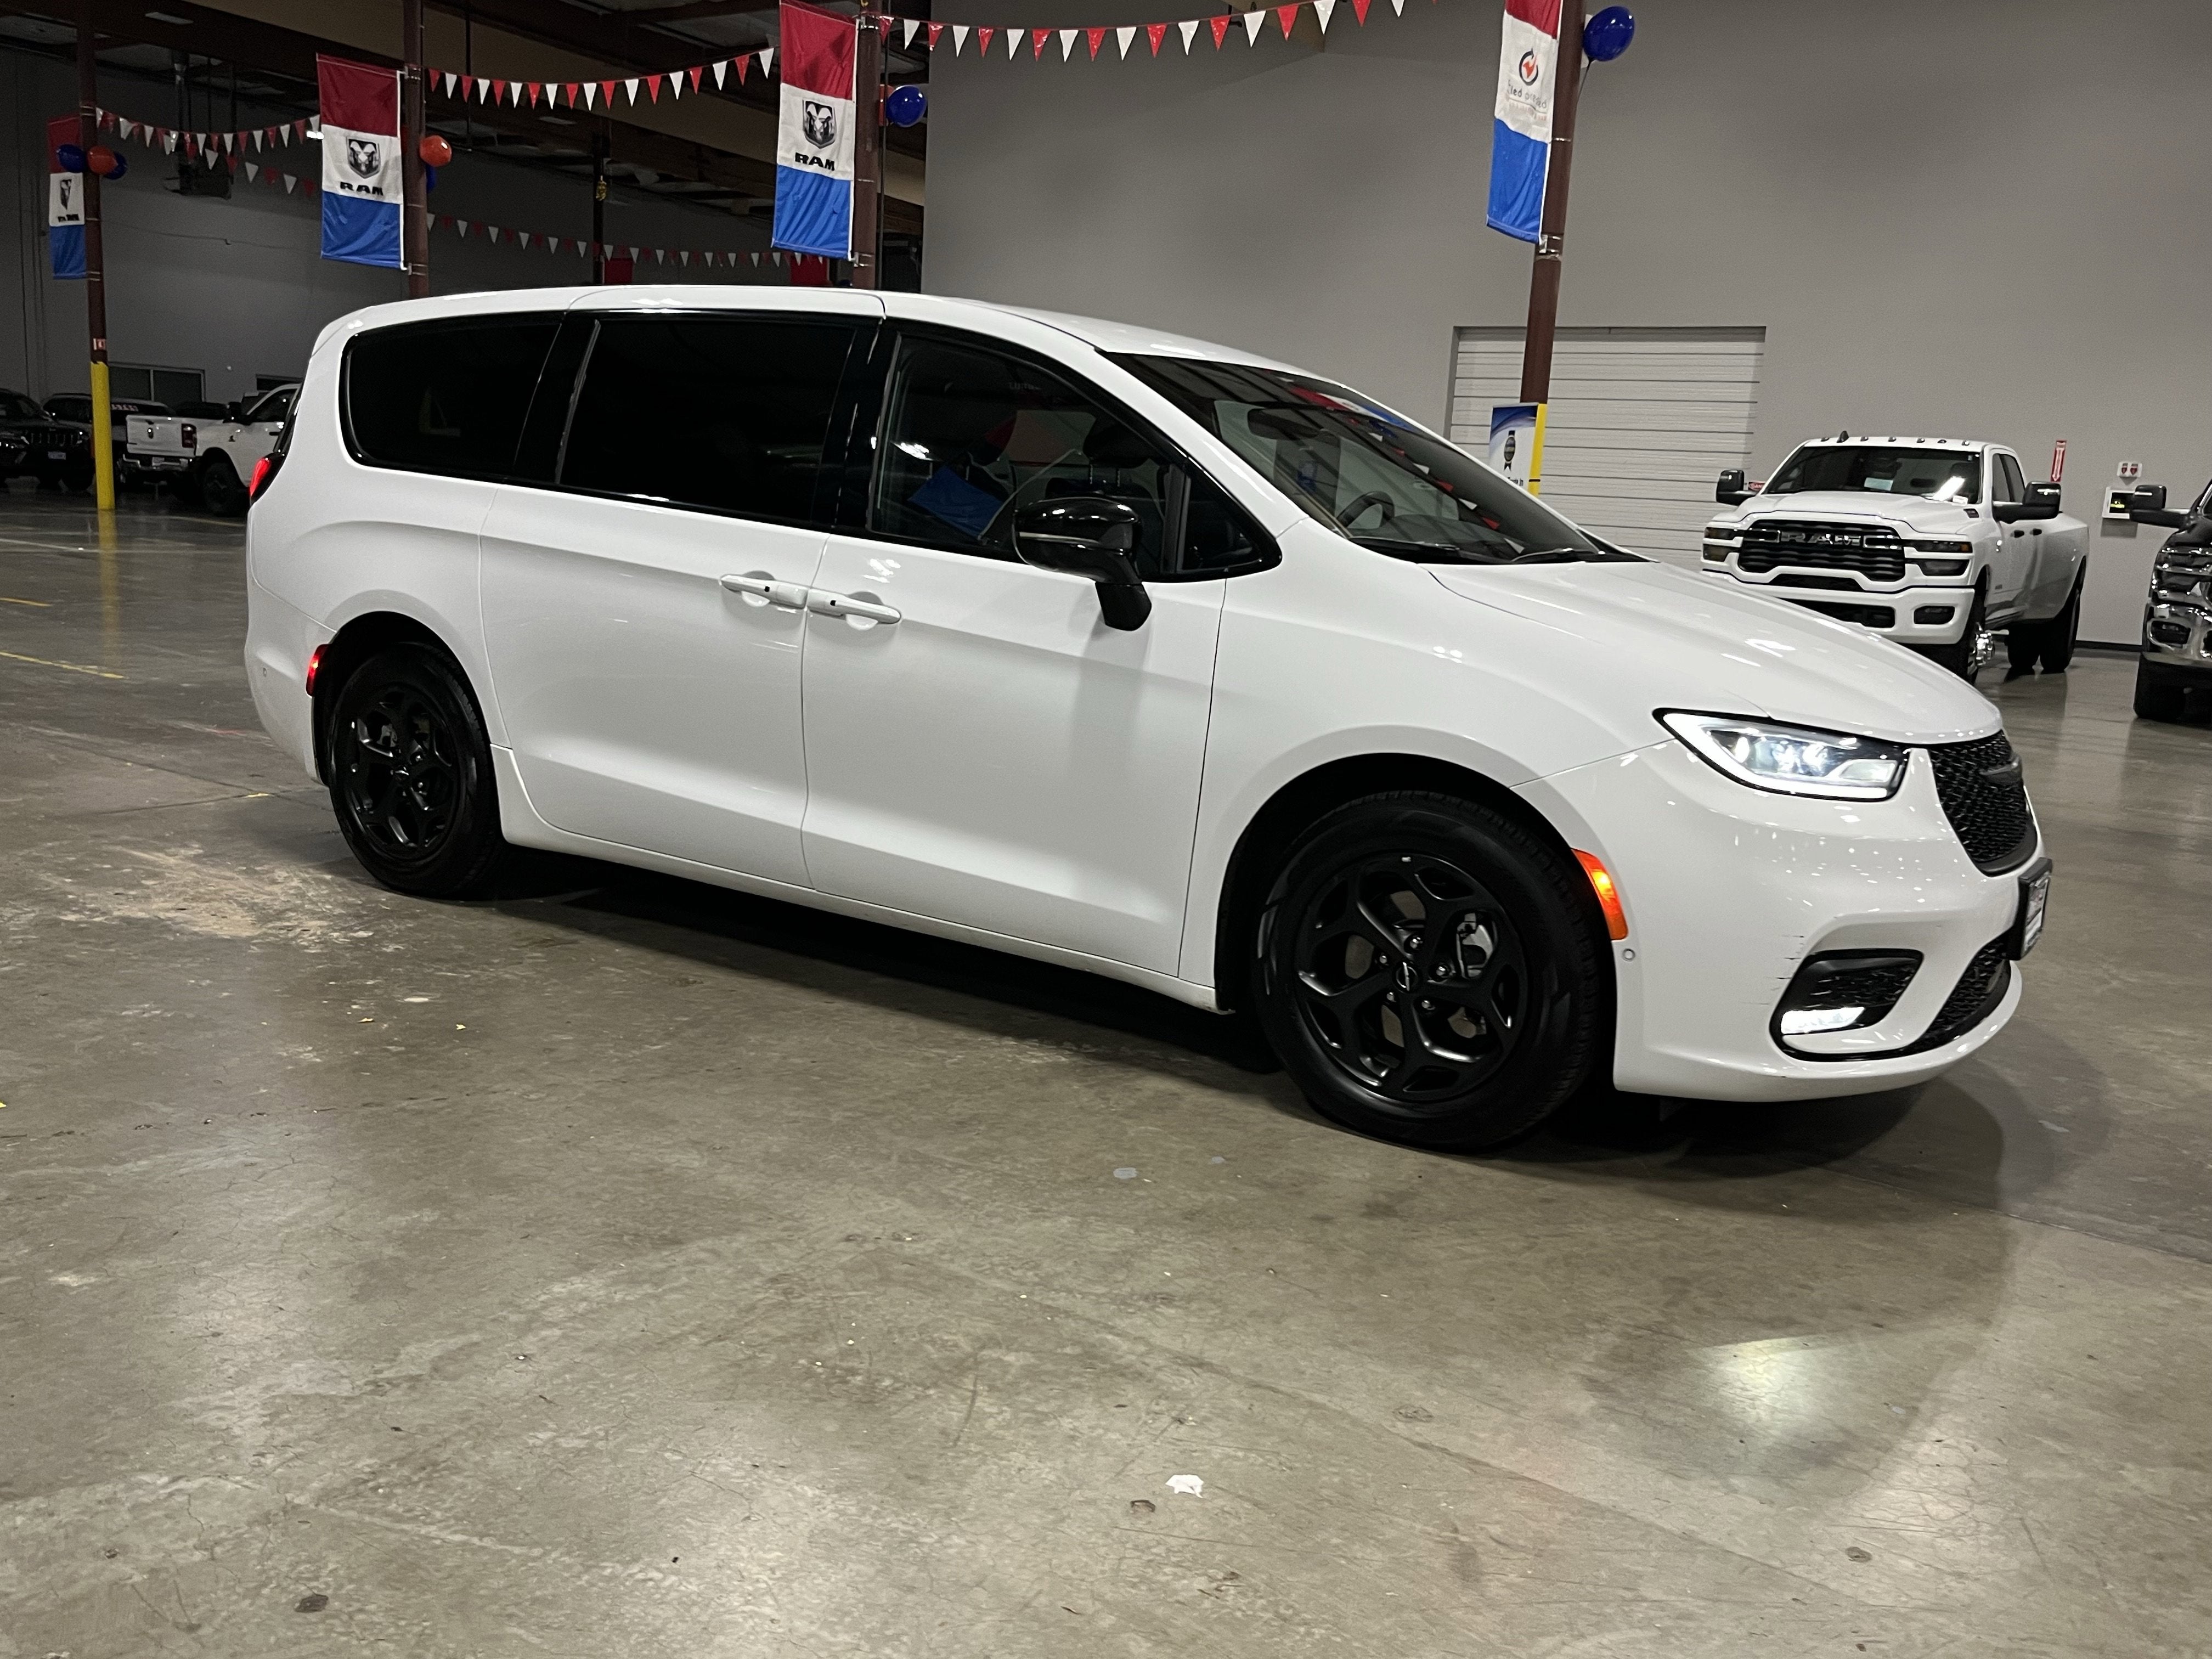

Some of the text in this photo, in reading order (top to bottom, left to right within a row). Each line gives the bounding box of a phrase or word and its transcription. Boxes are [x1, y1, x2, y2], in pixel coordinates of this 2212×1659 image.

[795, 152, 835, 171] RAM
[340, 182, 383, 196] RAM
[1781, 531, 1861, 546] RAM
